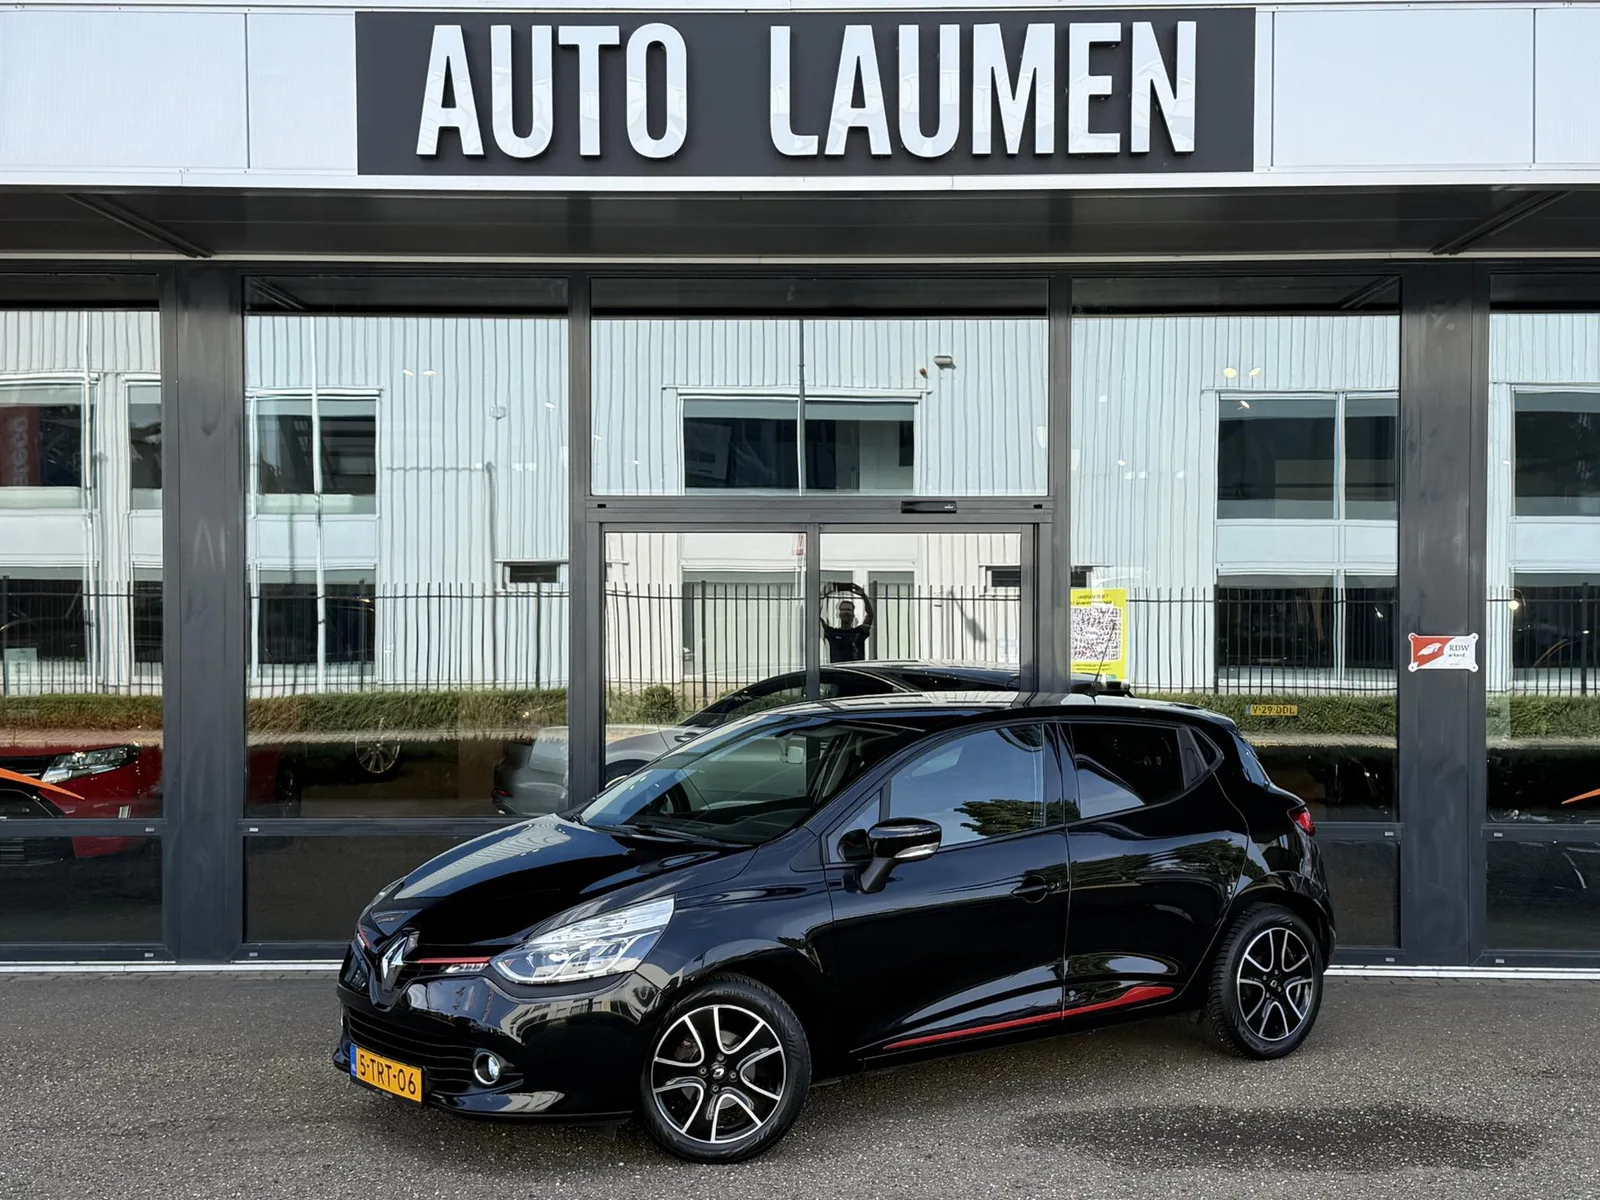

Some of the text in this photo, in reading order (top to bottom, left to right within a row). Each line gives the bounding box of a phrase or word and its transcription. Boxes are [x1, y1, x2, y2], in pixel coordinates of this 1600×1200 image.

[416, 21, 1197, 158] AUTO LAUMEN
[360, 1054, 416, 1095] 5-TRT-06
